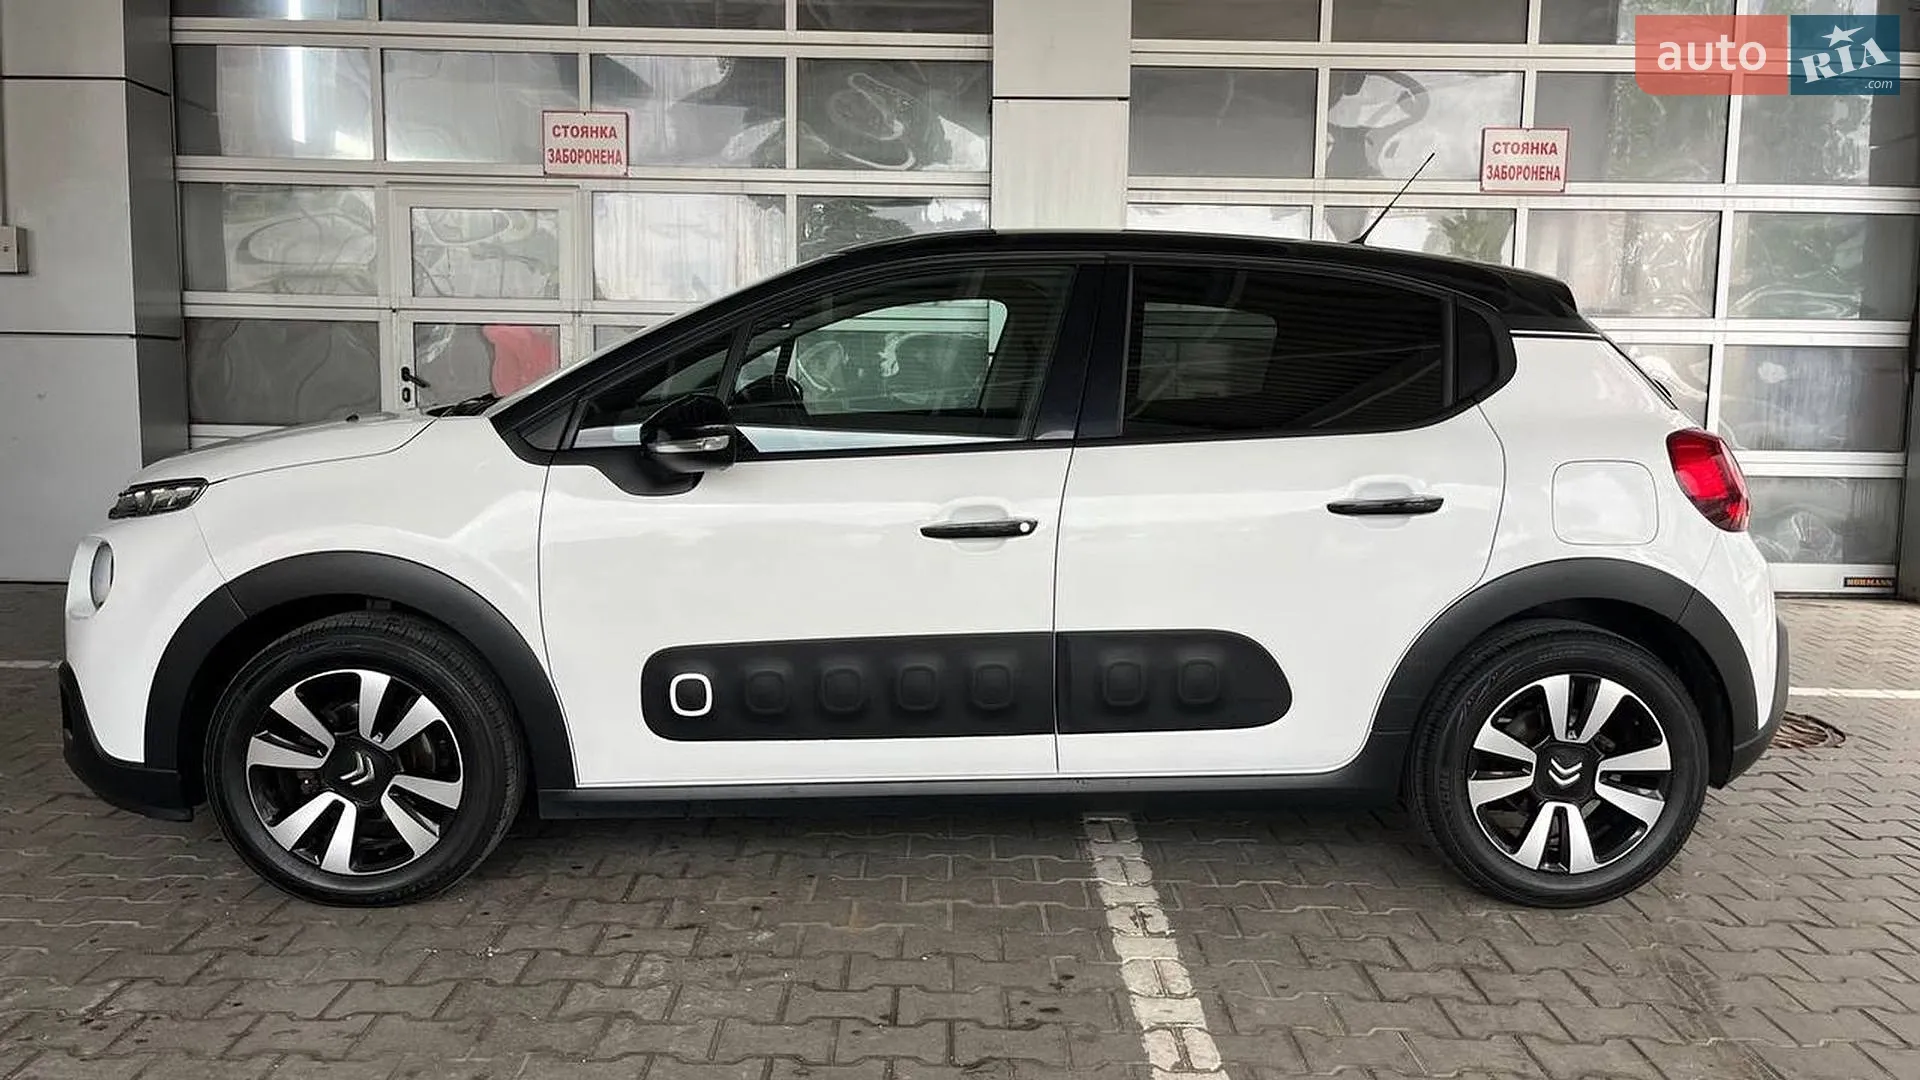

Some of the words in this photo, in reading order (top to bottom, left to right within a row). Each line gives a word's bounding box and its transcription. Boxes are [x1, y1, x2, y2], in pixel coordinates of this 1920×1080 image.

[552, 124, 618, 139] СТОЯНКА
[1492, 141, 1558, 155] СТОЯНКА
[547, 148, 623, 165] ЗАБОРОНЕНА
[1486, 164, 1561, 181] ЗАБОРОНЕНА
